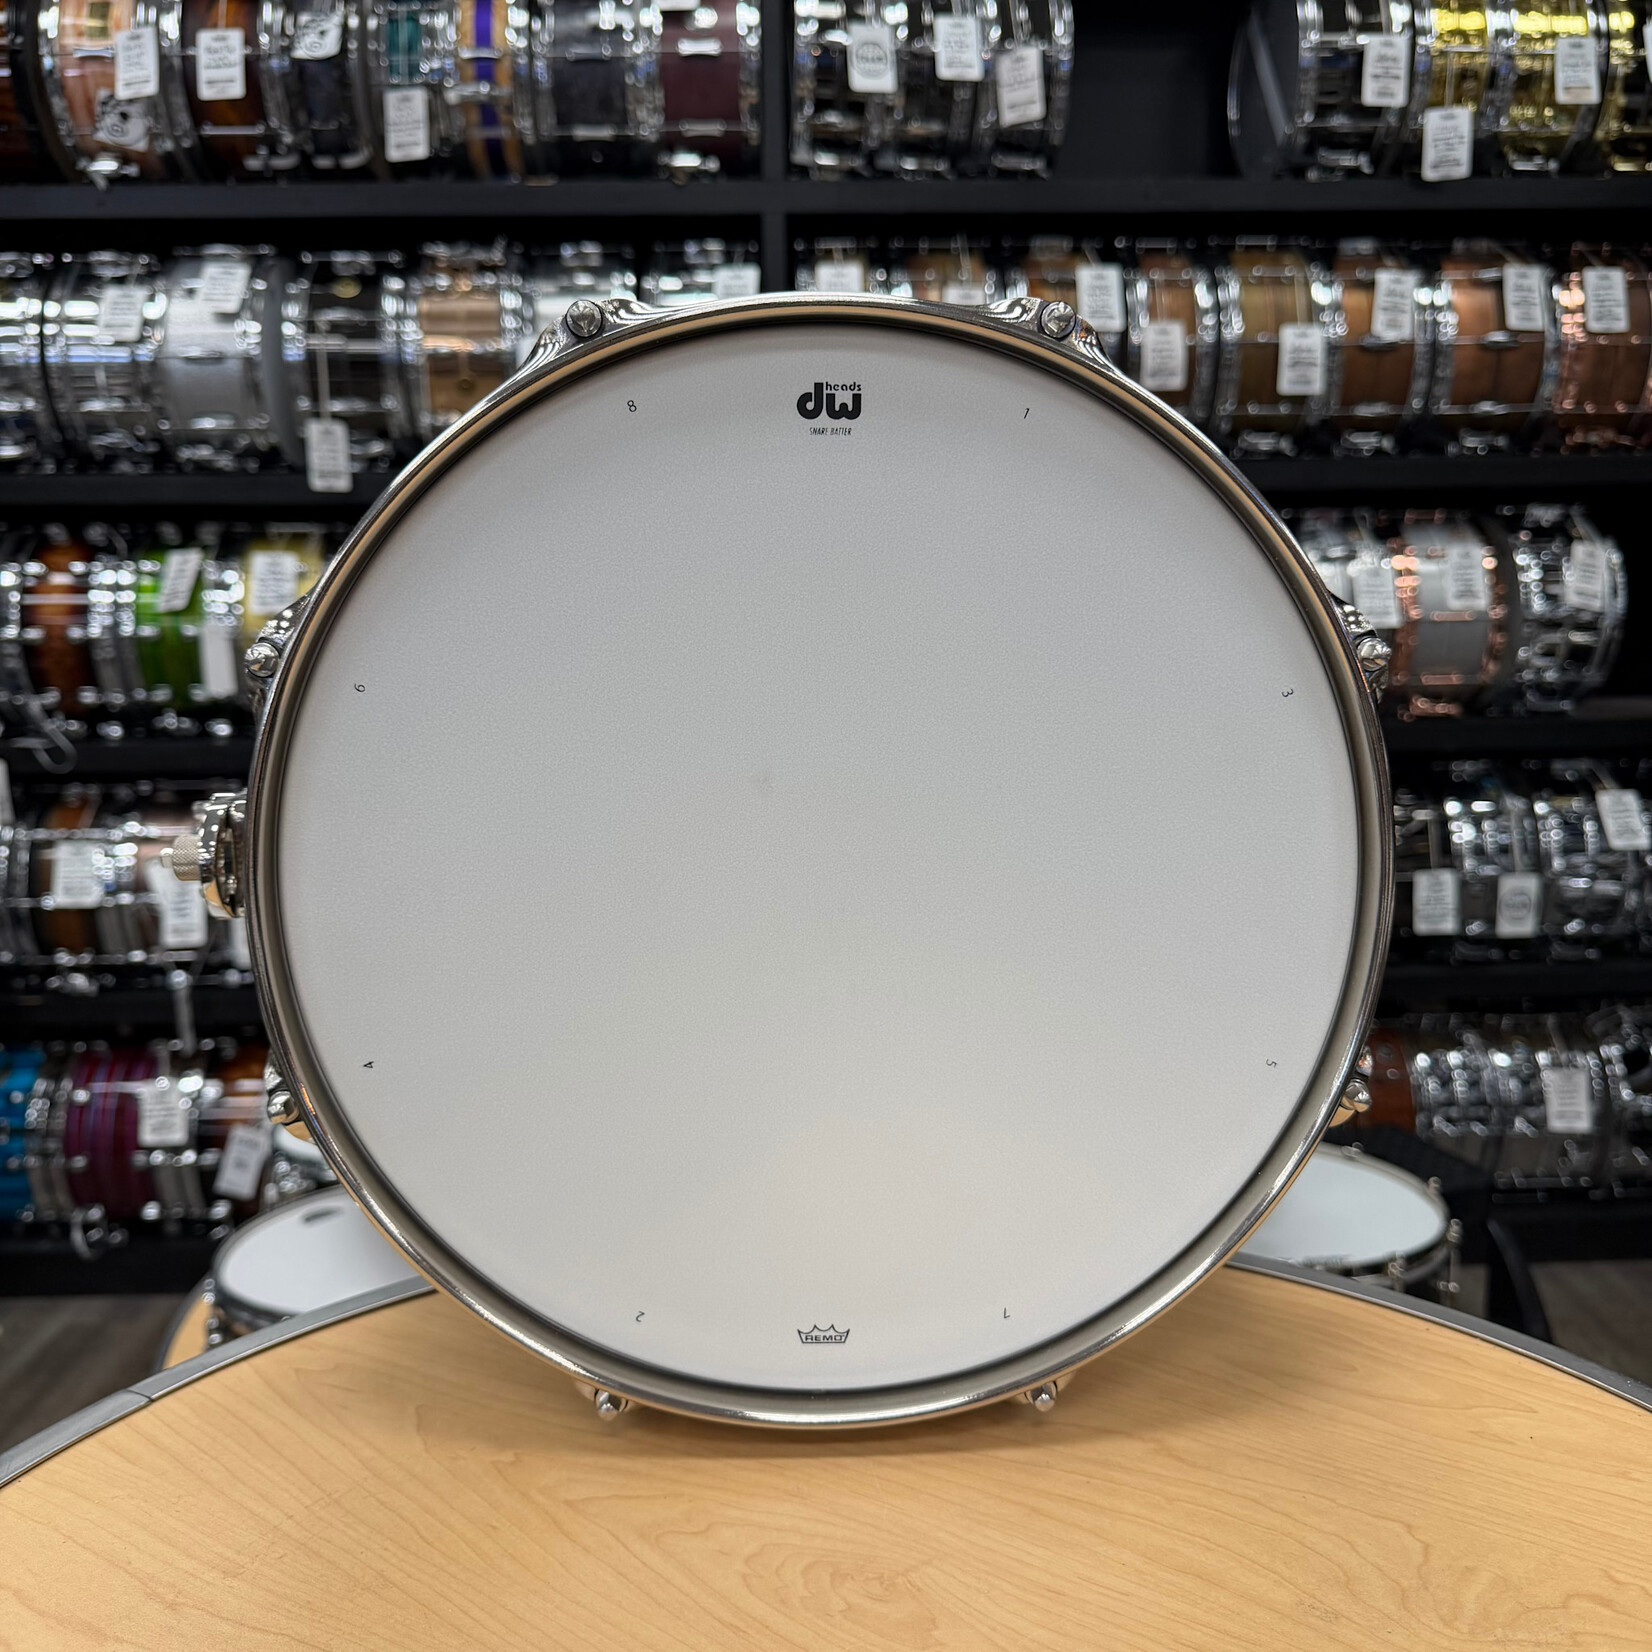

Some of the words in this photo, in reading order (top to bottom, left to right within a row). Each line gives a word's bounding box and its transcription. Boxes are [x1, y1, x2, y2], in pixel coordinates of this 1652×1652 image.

[825, 381, 862, 391] heads
[627, 399, 637, 413] 8
[796, 382, 862, 420] dw
[1023, 407, 1030, 420] 1
[809, 427, 828, 436] SNARE
[830, 427, 852, 436] BATTER
[1281, 688, 1295, 697] 3
[362, 1060, 375, 1068] 4
[1266, 1058, 1278, 1068] 5
[635, 1310, 646, 1323] 2
[1003, 1307, 1011, 1320] 7
[805, 1334, 844, 1342] REMO
